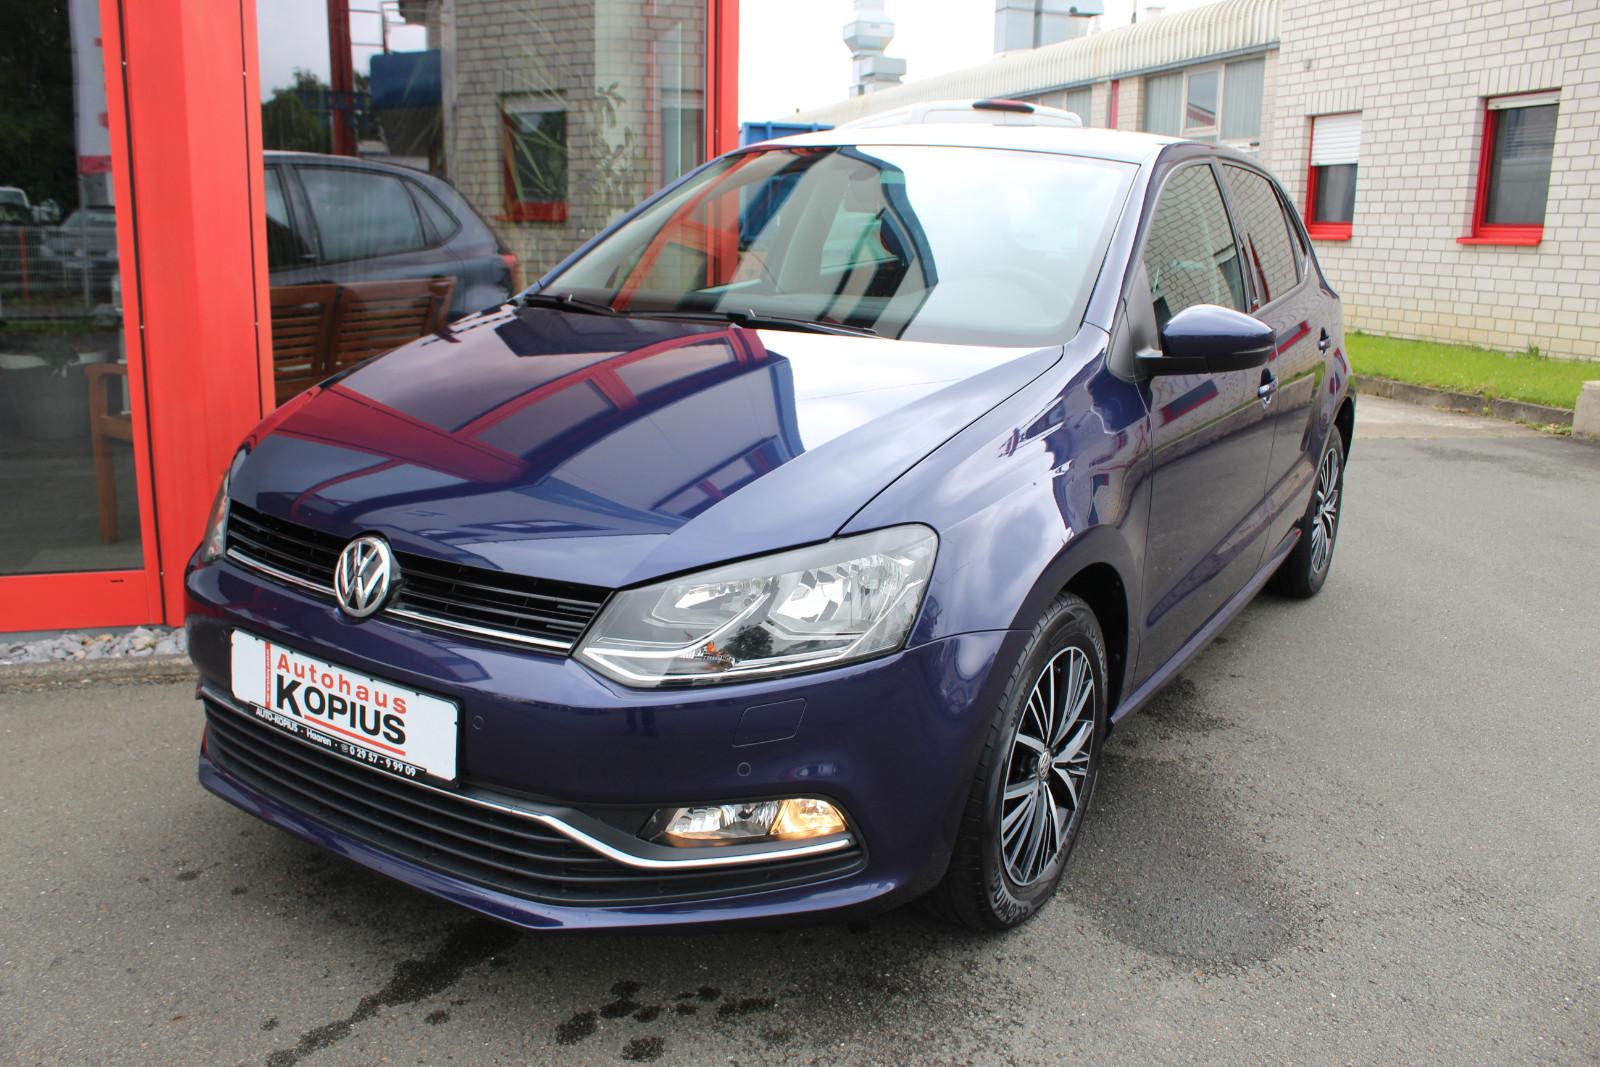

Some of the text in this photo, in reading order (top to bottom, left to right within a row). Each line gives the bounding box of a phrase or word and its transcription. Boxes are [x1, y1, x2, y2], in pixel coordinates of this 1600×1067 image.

[337, 539, 388, 614] VW
[277, 653, 407, 715] Autohaus
[277, 673, 406, 745] KOPIUS
[356, 749, 366, 760] 29
[368, 753, 378, 764] 57
[385, 758, 391, 768] 9
[393, 761, 403, 773] 99
[405, 766, 416, 777] 09
